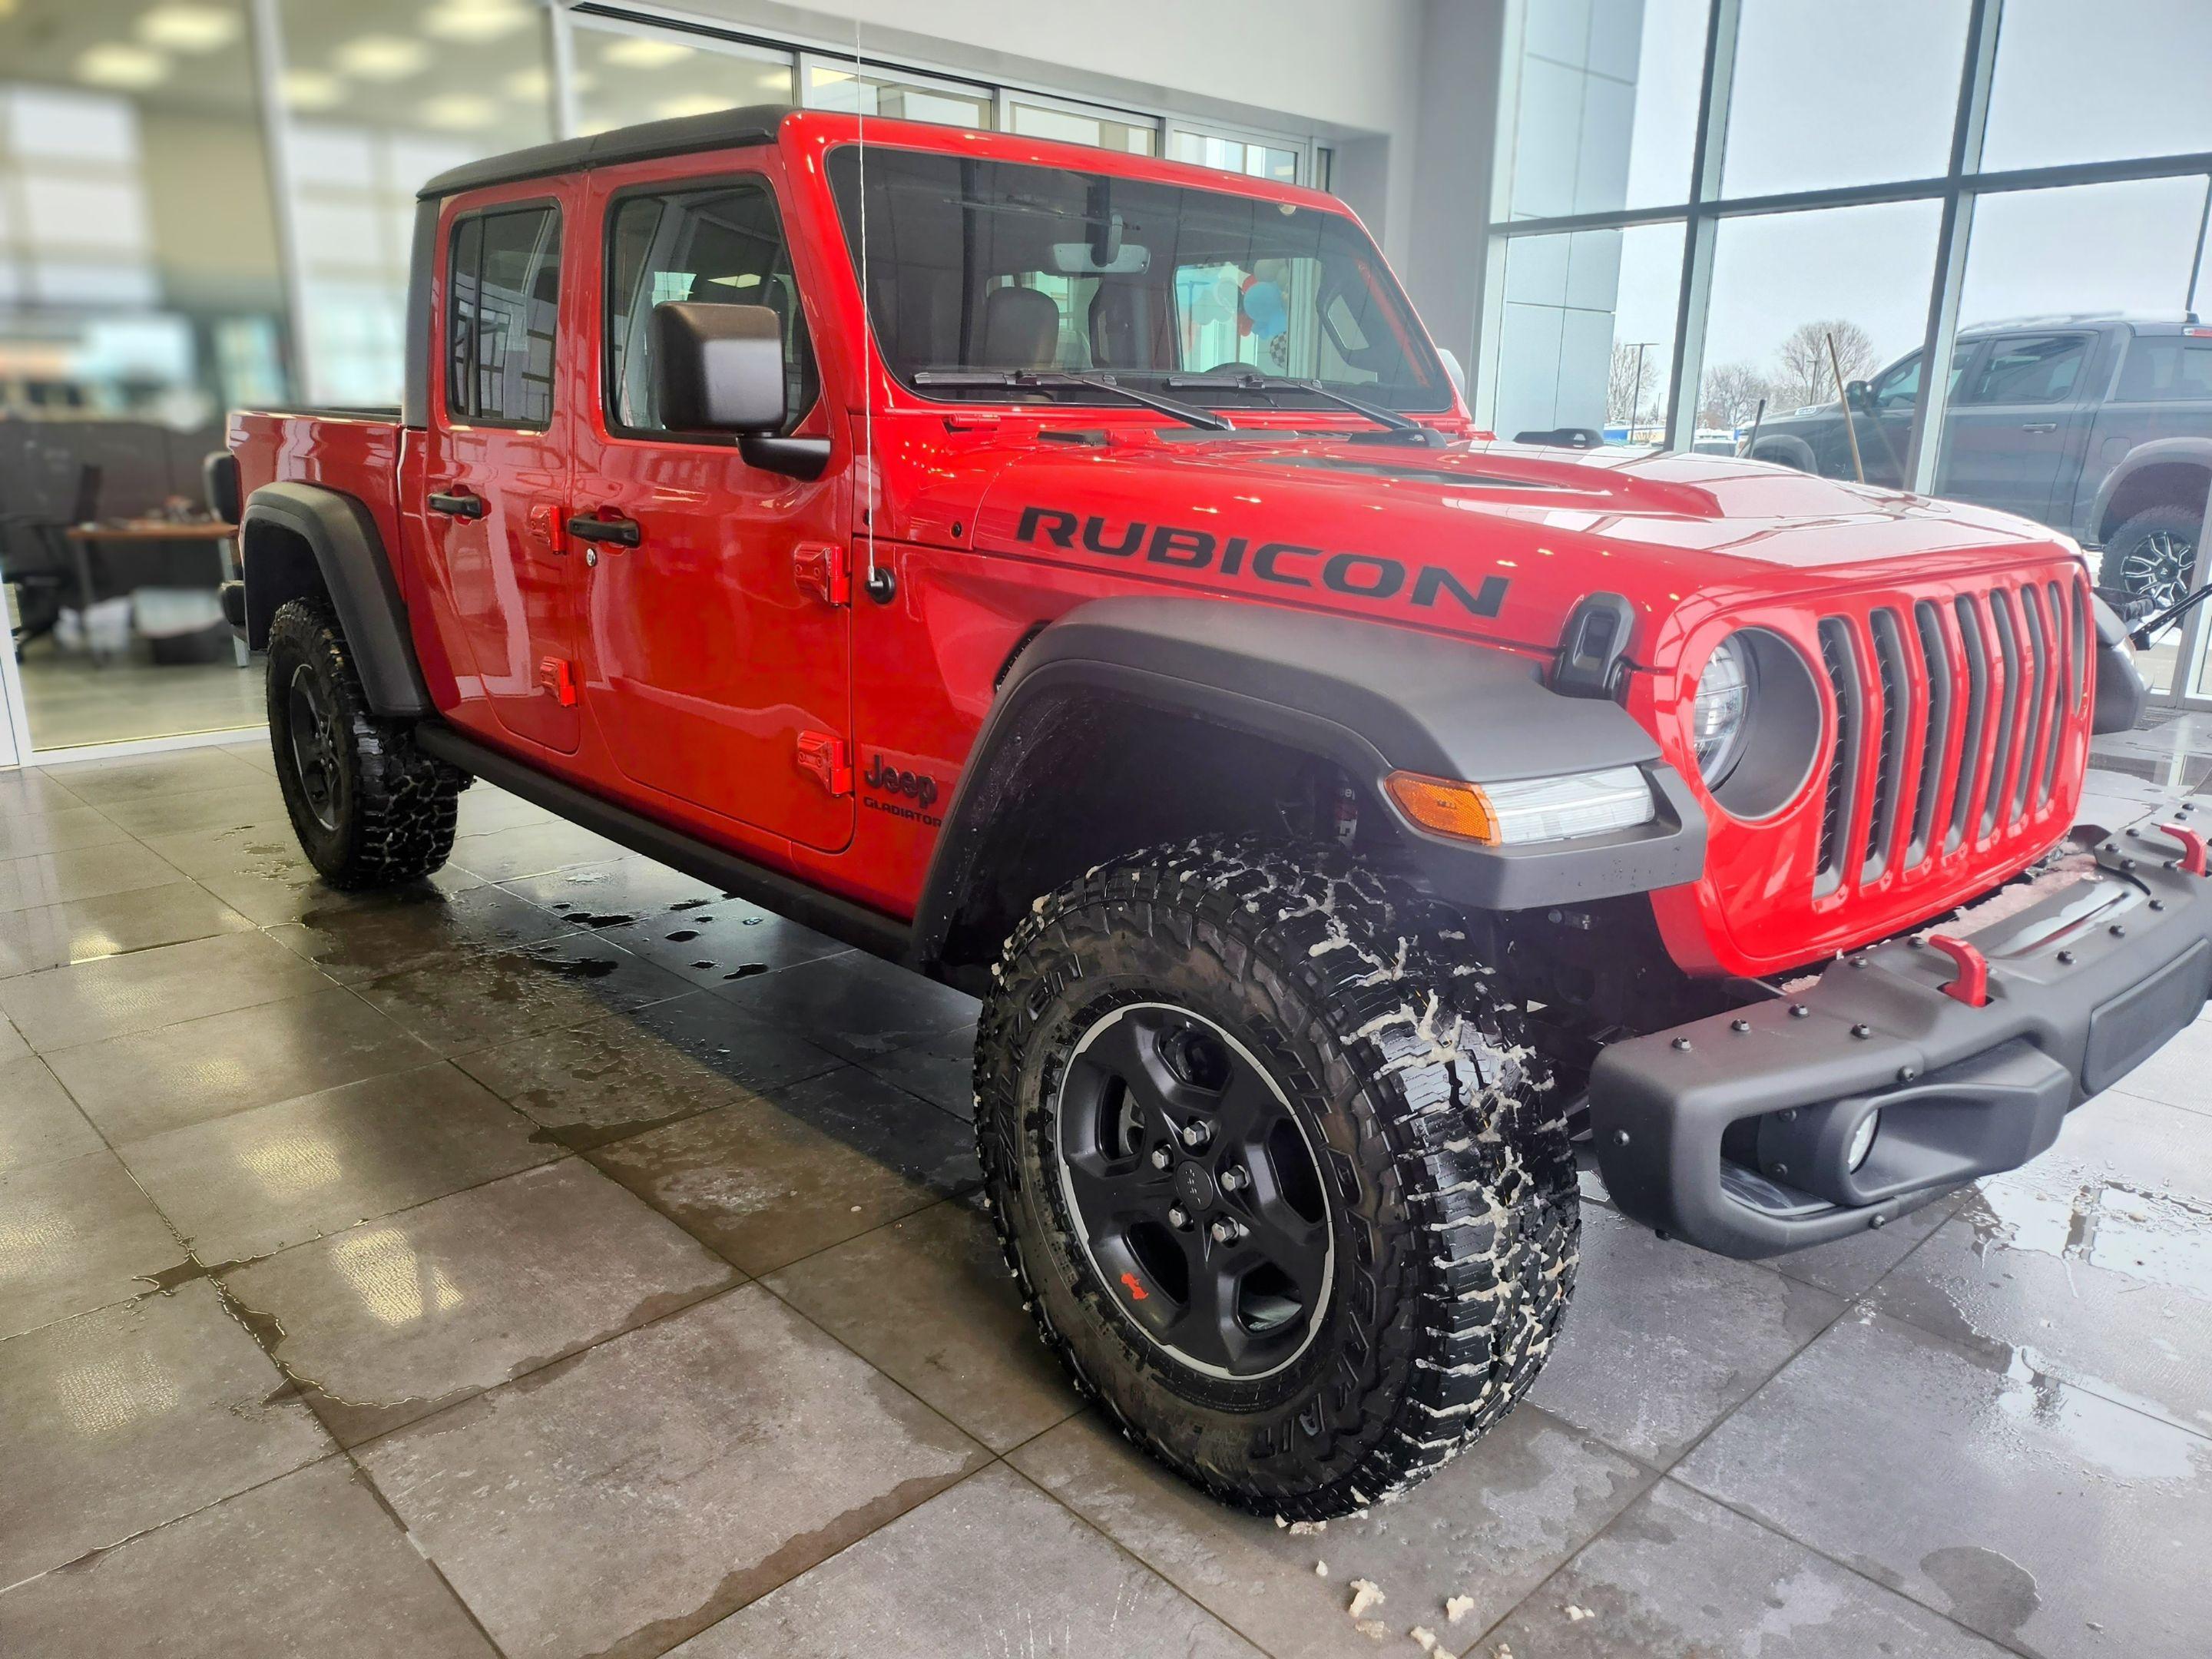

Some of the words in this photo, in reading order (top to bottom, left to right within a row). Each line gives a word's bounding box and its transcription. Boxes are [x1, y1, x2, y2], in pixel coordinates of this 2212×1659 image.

[1017, 506, 1511, 618] RUBICON
[864, 754, 938, 809] Jeep
[863, 796, 942, 827] GLADIATOR
